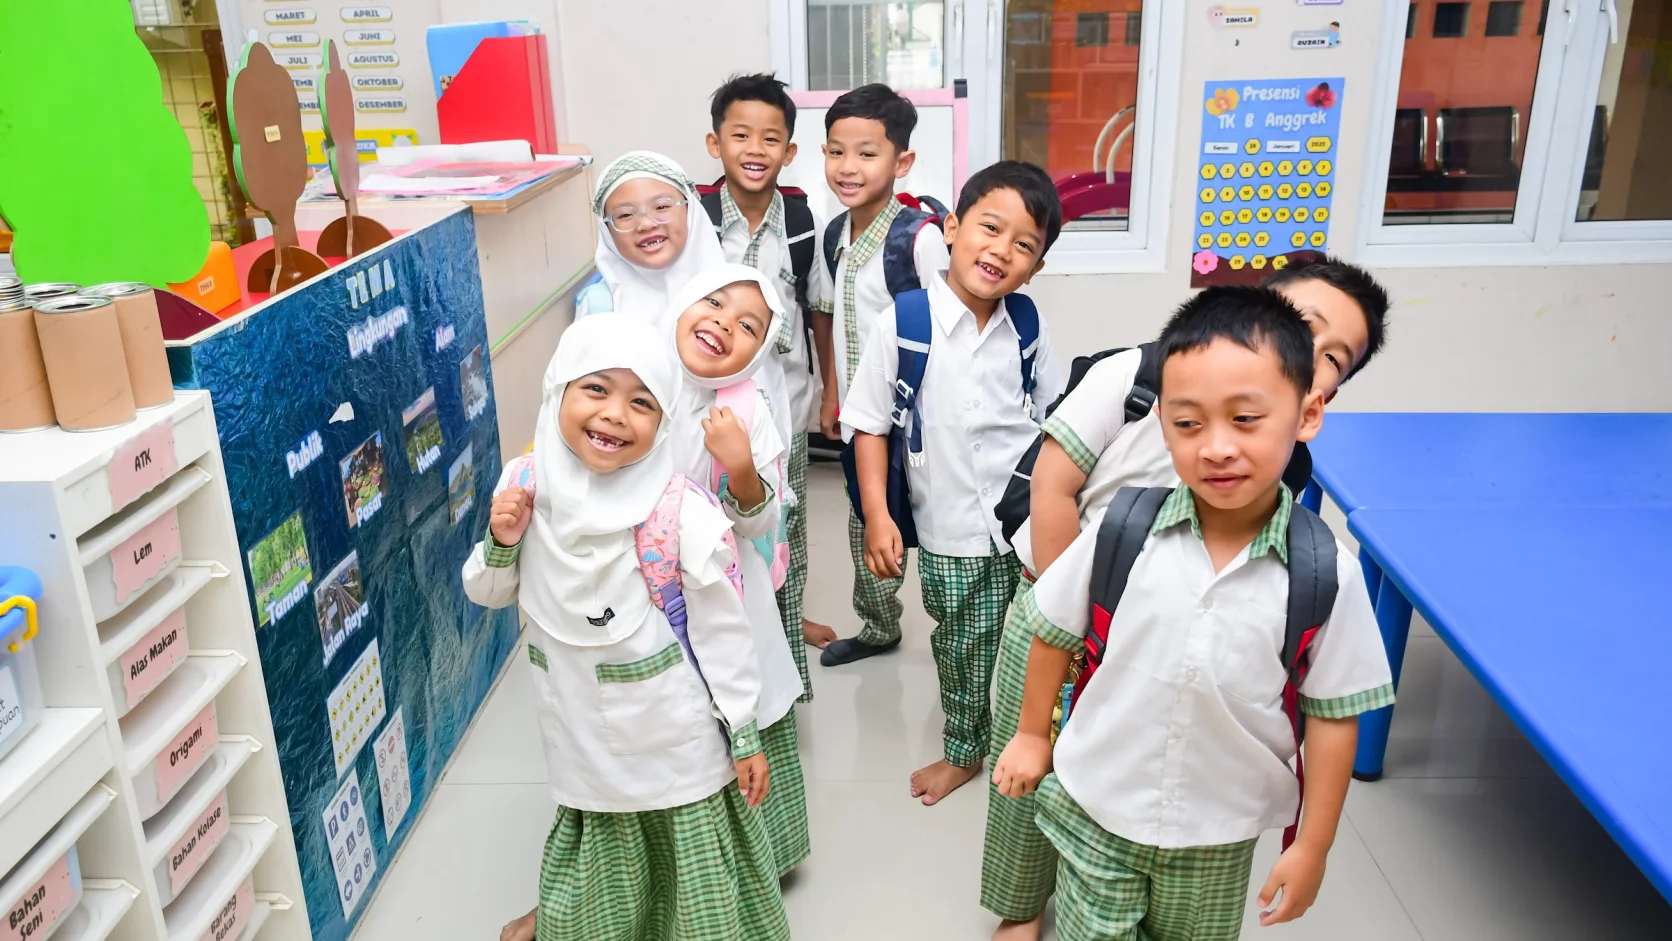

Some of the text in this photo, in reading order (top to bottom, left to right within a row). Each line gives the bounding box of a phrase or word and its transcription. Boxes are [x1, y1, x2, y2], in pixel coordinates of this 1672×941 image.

[276, 12, 305, 20] MARET
[353, 10, 380, 18] APRIL
[286, 34, 302, 42] MEI
[354, 55, 394, 63] AGUSTUS
[1243, 84, 1300, 102] Presensi
[1218, 109, 1327, 132] TK B Anggrek
[346, 260, 396, 309] TEMA
[347, 306, 408, 360] Lingkungan
[134, 448, 152, 472] ATK
[286, 430, 324, 480] Publik
[416, 444, 441, 476] Hutan
[356, 490, 382, 528] Pasar
[133, 541, 153, 565] Lem
[266, 579, 308, 627] Taman
[323, 628, 345, 668] Jalan
[344, 600, 369, 637] Raya
[130, 628, 177, 680] Alas Makan
[169, 722, 202, 767] Origami
[172, 806, 221, 872] Bahan Kolase
[9, 884, 46, 931] Bahan
[20, 908, 43, 941] Seni
[211, 894, 236, 935] Barang
[216, 912, 236, 941] Bekas
